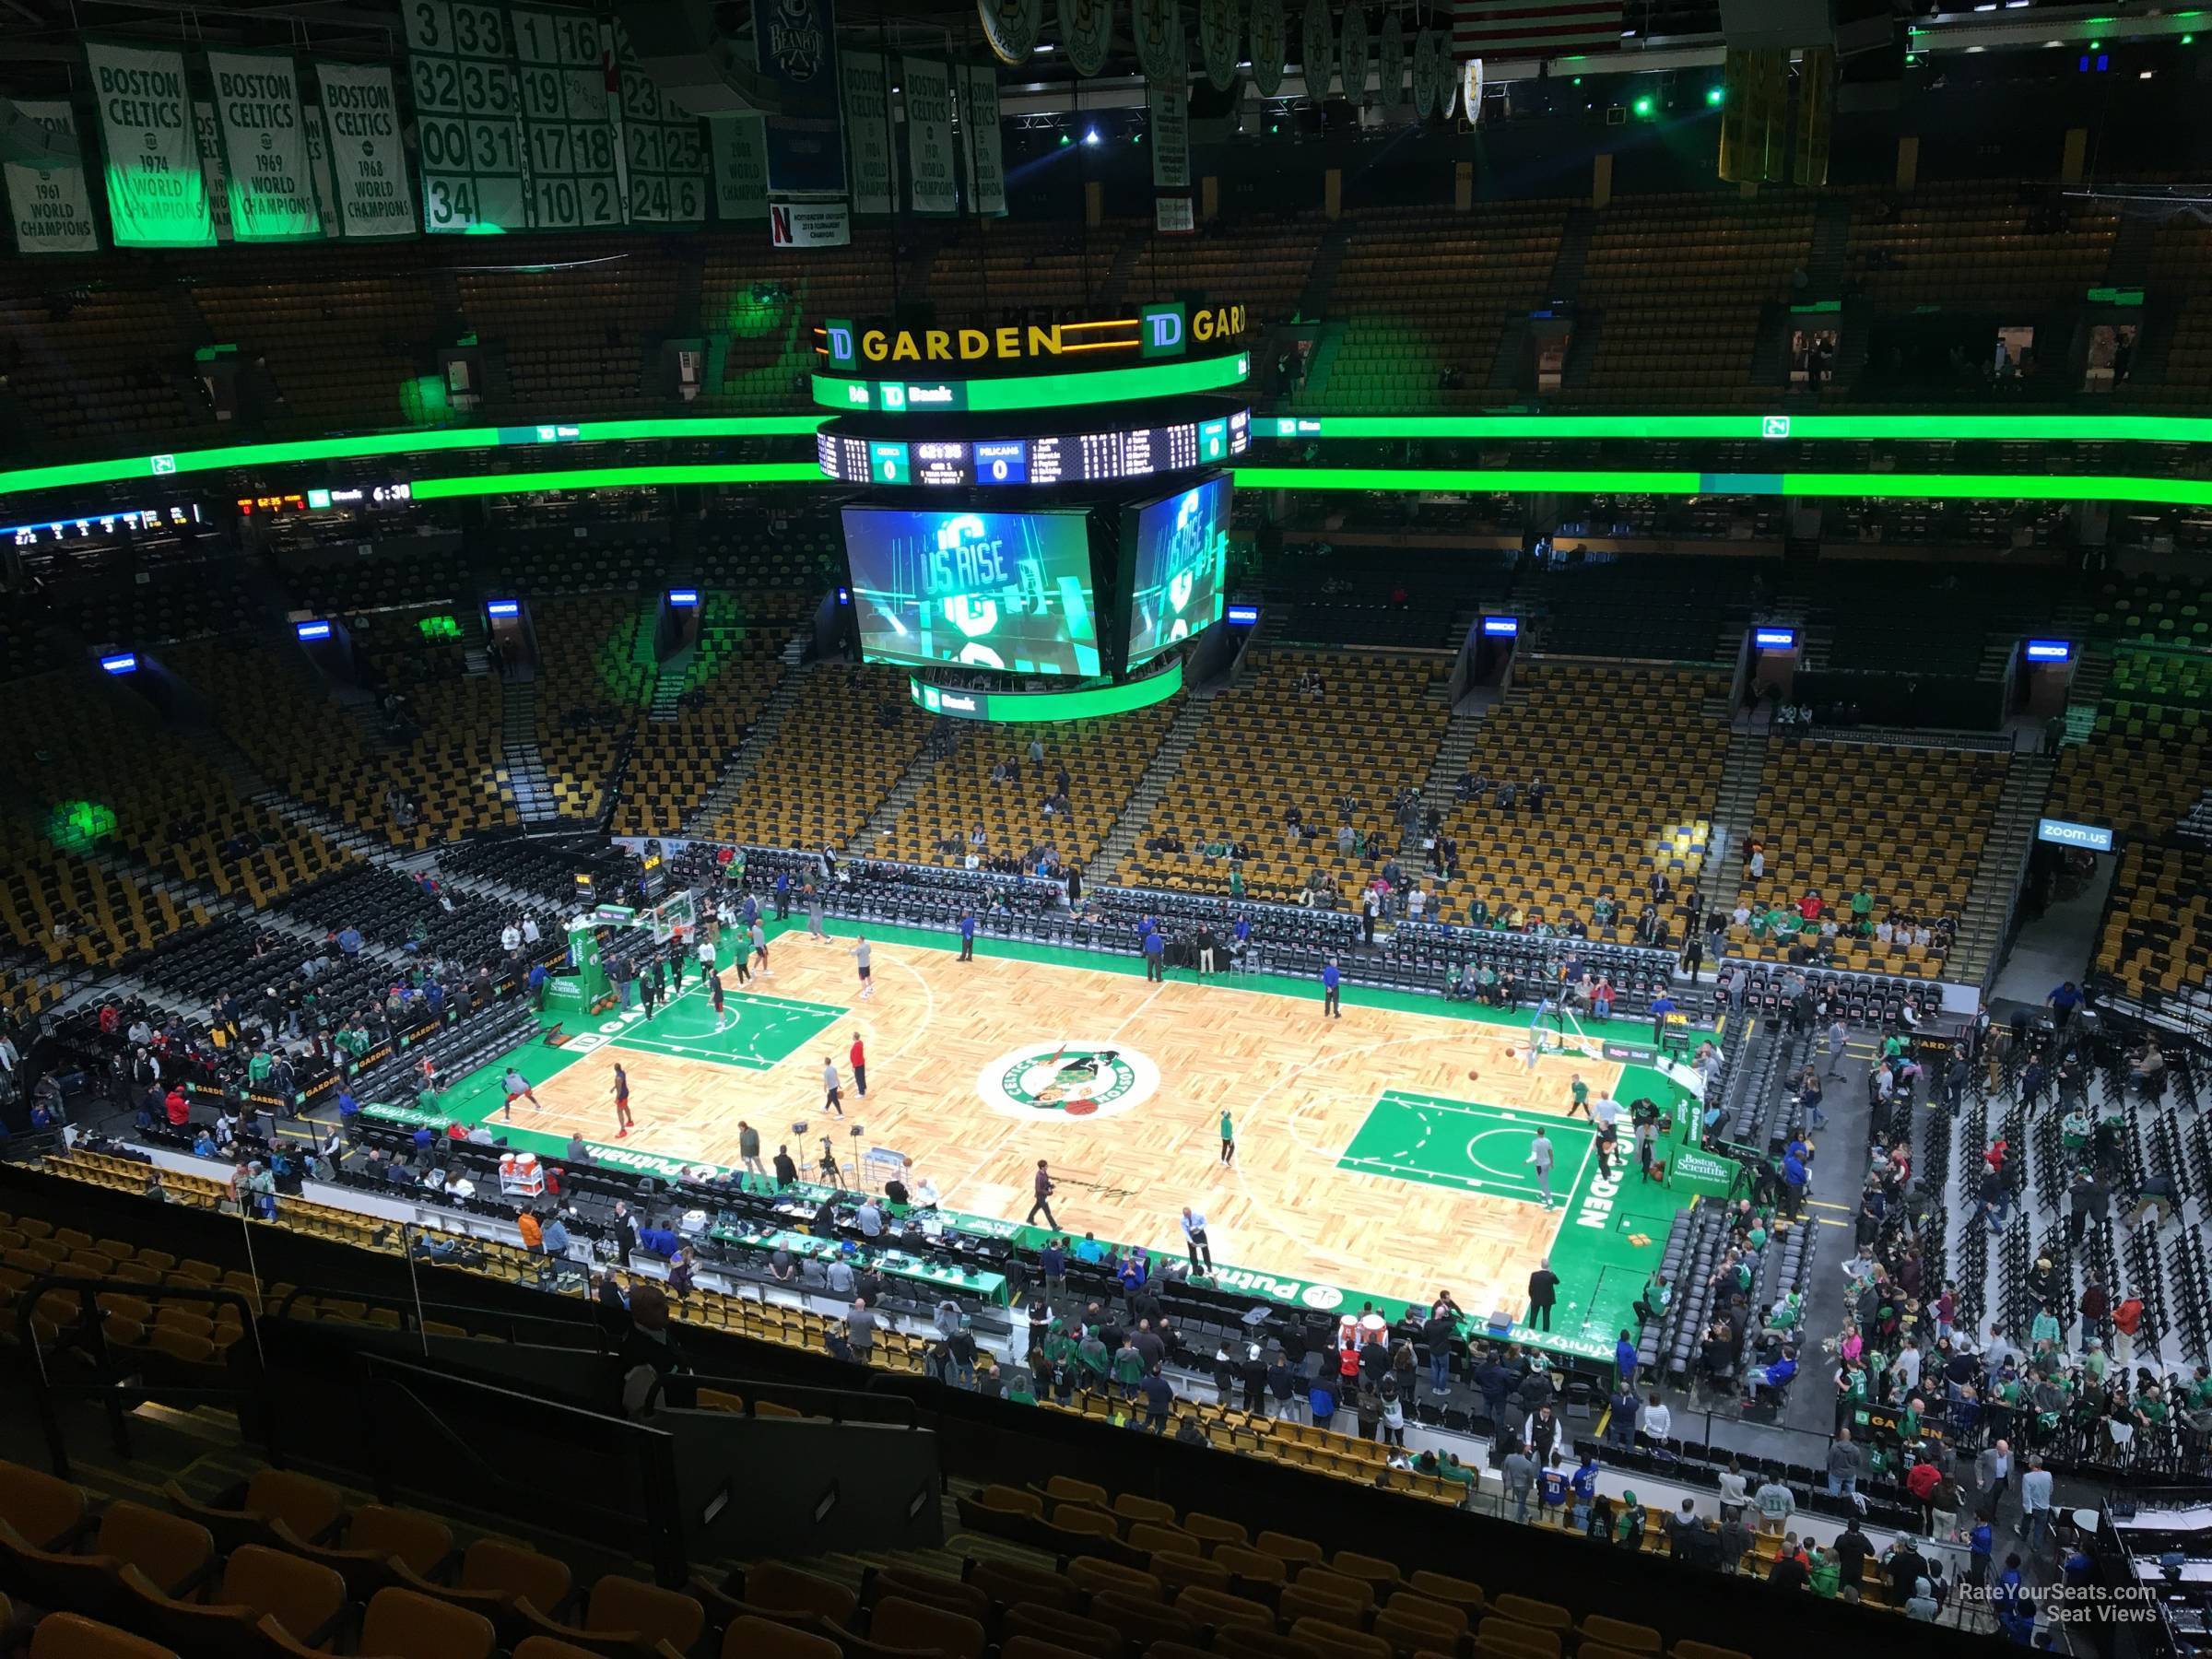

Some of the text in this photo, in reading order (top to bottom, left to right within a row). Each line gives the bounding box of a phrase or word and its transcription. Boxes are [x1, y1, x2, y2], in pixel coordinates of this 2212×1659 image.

[417, 4, 438, 46] 3
[456, 8, 501, 53] 33
[524, 18, 539, 59] 1
[562, 21, 595, 60] 16
[100, 66, 181, 98] BOSTON
[219, 73, 291, 100] BOSTON
[417, 60, 458, 106] 32
[465, 67, 509, 110] 35
[525, 72, 558, 112] 19
[326, 84, 389, 109] BOSTON
[624, 74, 655, 116] 23
[110, 99, 182, 127] CELTICS
[229, 102, 293, 127] CELTICS
[335, 112, 392, 135] CELTICS
[424, 123, 465, 166] 00
[477, 126, 514, 167] 31
[536, 128, 564, 168] 17
[577, 129, 610, 168] 18
[632, 128, 660, 167] 21
[667, 131, 700, 168] 25
[140, 155, 169, 173] 1974
[255, 155, 282, 171] 1969
[359, 161, 382, 176] 1968
[36, 185, 59, 199] 1961
[132, 179, 182, 196] WORLD
[252, 177, 294, 194] WORLD
[355, 182, 393, 197] WORLD
[30, 204, 74, 218] WORLD
[242, 197, 310, 215] CHAMPIONS
[347, 200, 408, 218] CHAMPIONS
[432, 181, 472, 223] 34
[542, 183, 574, 223] 10
[591, 182, 610, 221] 2
[635, 180, 666, 218] 24
[681, 182, 695, 216] 6
[21, 221, 90, 236] CHAMPIONS
[772, 206, 793, 243] N
[830, 324, 1062, 361] TD GARDEN
[1147, 313, 1181, 347] TD
[884, 460, 896, 479] 0
[993, 460, 1008, 479] 0
[258, 498, 280, 507] 62:35
[373, 485, 409, 501] 6:30
[15, 535, 37, 545] 2/2
[955, 540, 1008, 590] RISE
[2044, 826, 2108, 844] zoom.us
[409, 1020, 441, 1041] GARDEN
[359, 1047, 391, 1067] GARDEN
[306, 1076, 340, 1098] GARDEN
[1004, 1058, 1039, 1095] CELTICS
[1095, 1065, 1132, 1103] BOSTON
[251, 1095, 285, 1106] GARDEN
[1677, 1159, 1728, 1178] Scientific
[1685, 1154, 1717, 1168] Boston
[1546, 1335, 1617, 1358] xfinity
[1871, 1416, 1943, 1440] GAEN
[1548, 1482, 1559, 1493] 10
